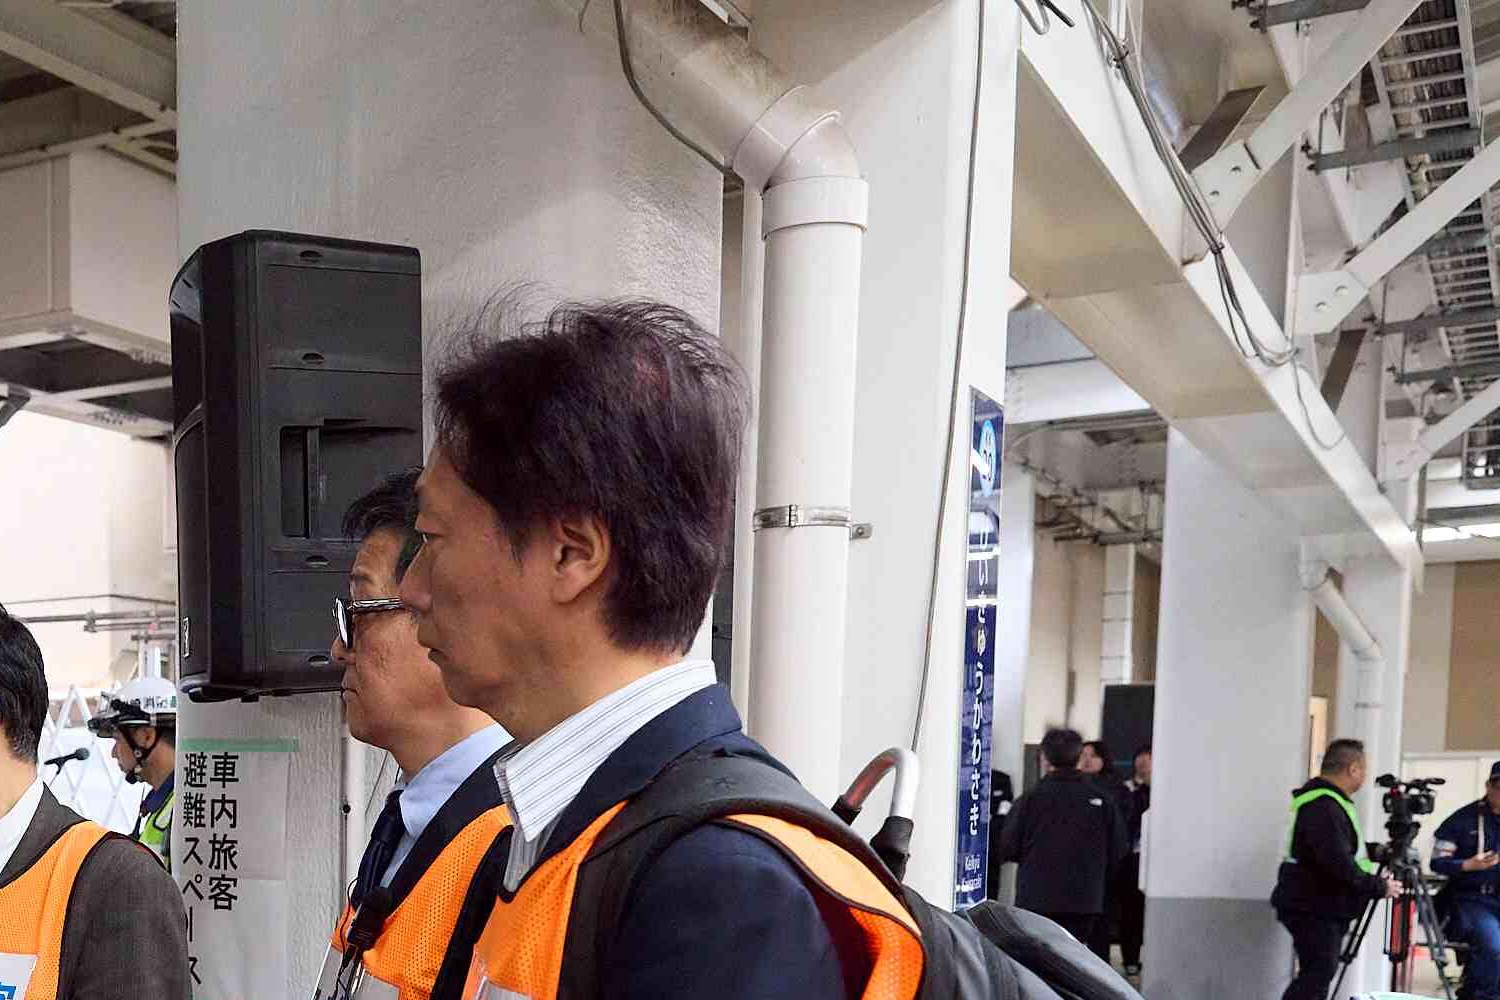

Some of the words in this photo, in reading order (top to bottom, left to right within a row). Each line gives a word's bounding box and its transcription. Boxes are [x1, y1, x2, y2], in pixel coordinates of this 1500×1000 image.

[182, 751, 208, 986] 避難スペース
[208, 752, 240, 911] 車内旅客
